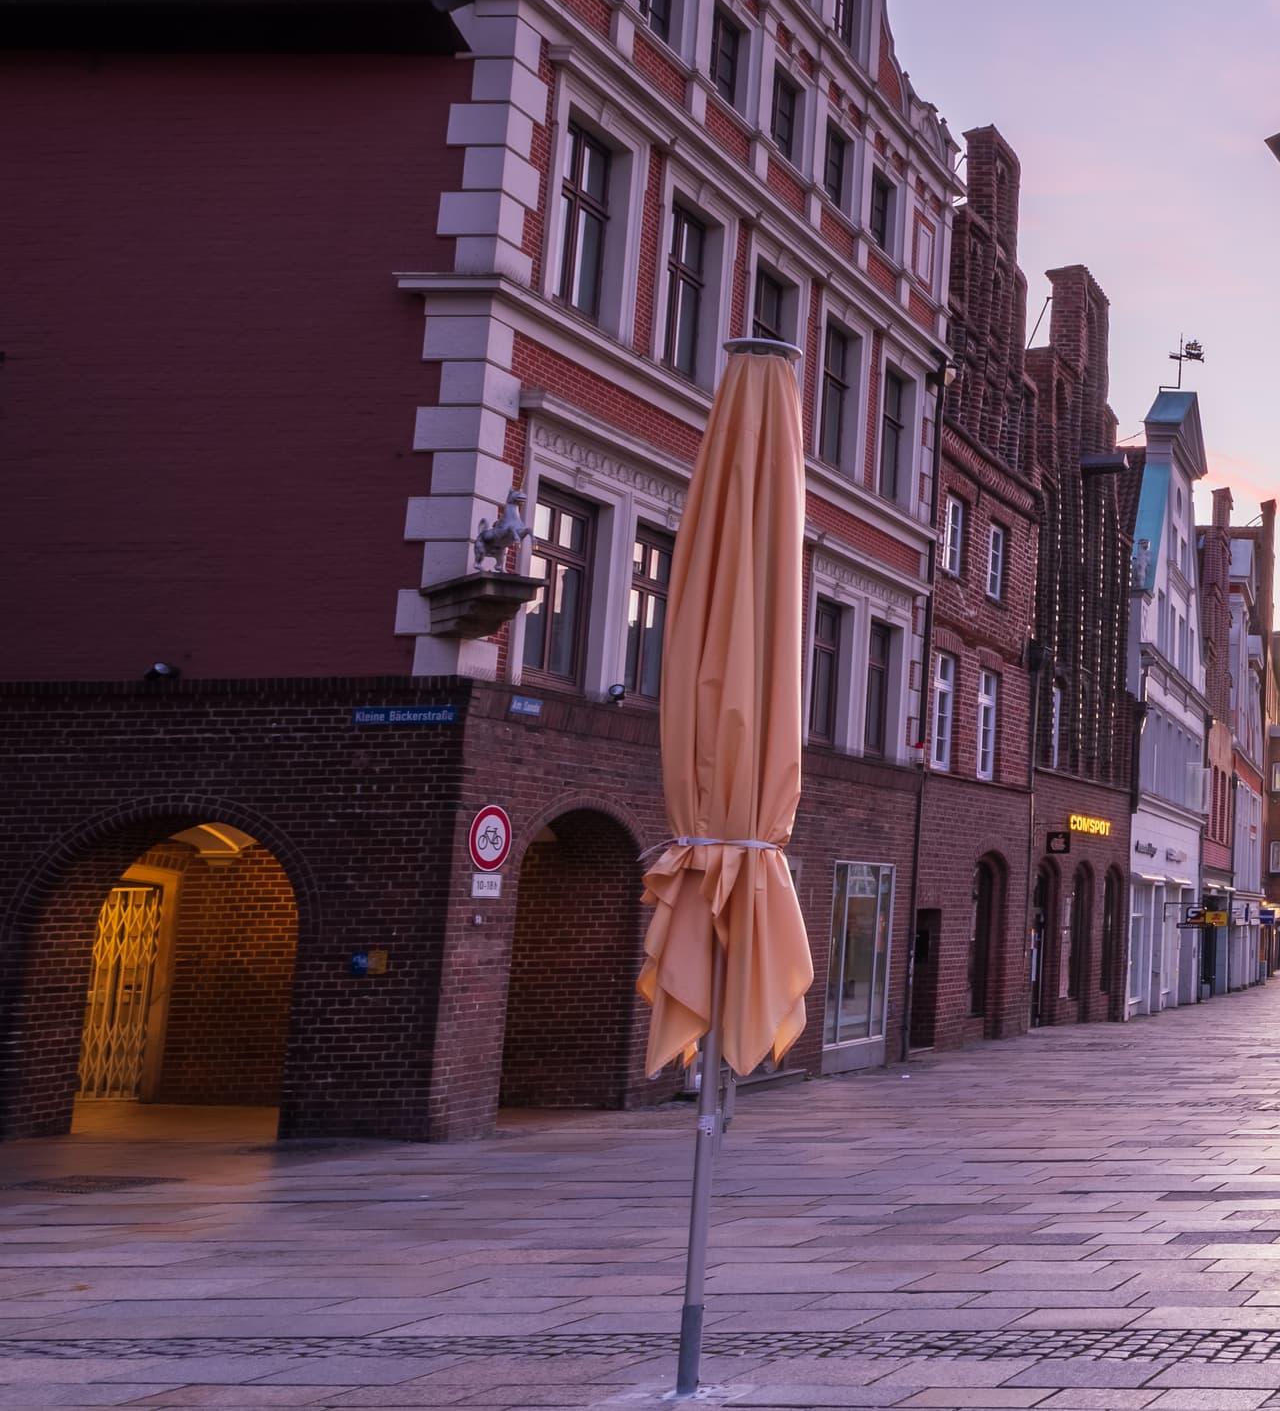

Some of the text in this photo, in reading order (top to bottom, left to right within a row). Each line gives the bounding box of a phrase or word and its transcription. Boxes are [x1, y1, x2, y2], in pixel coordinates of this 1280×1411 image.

[355, 709, 454, 722] Kleine Bäckerstraße
[1070, 815, 1112, 837] COMSPOT
